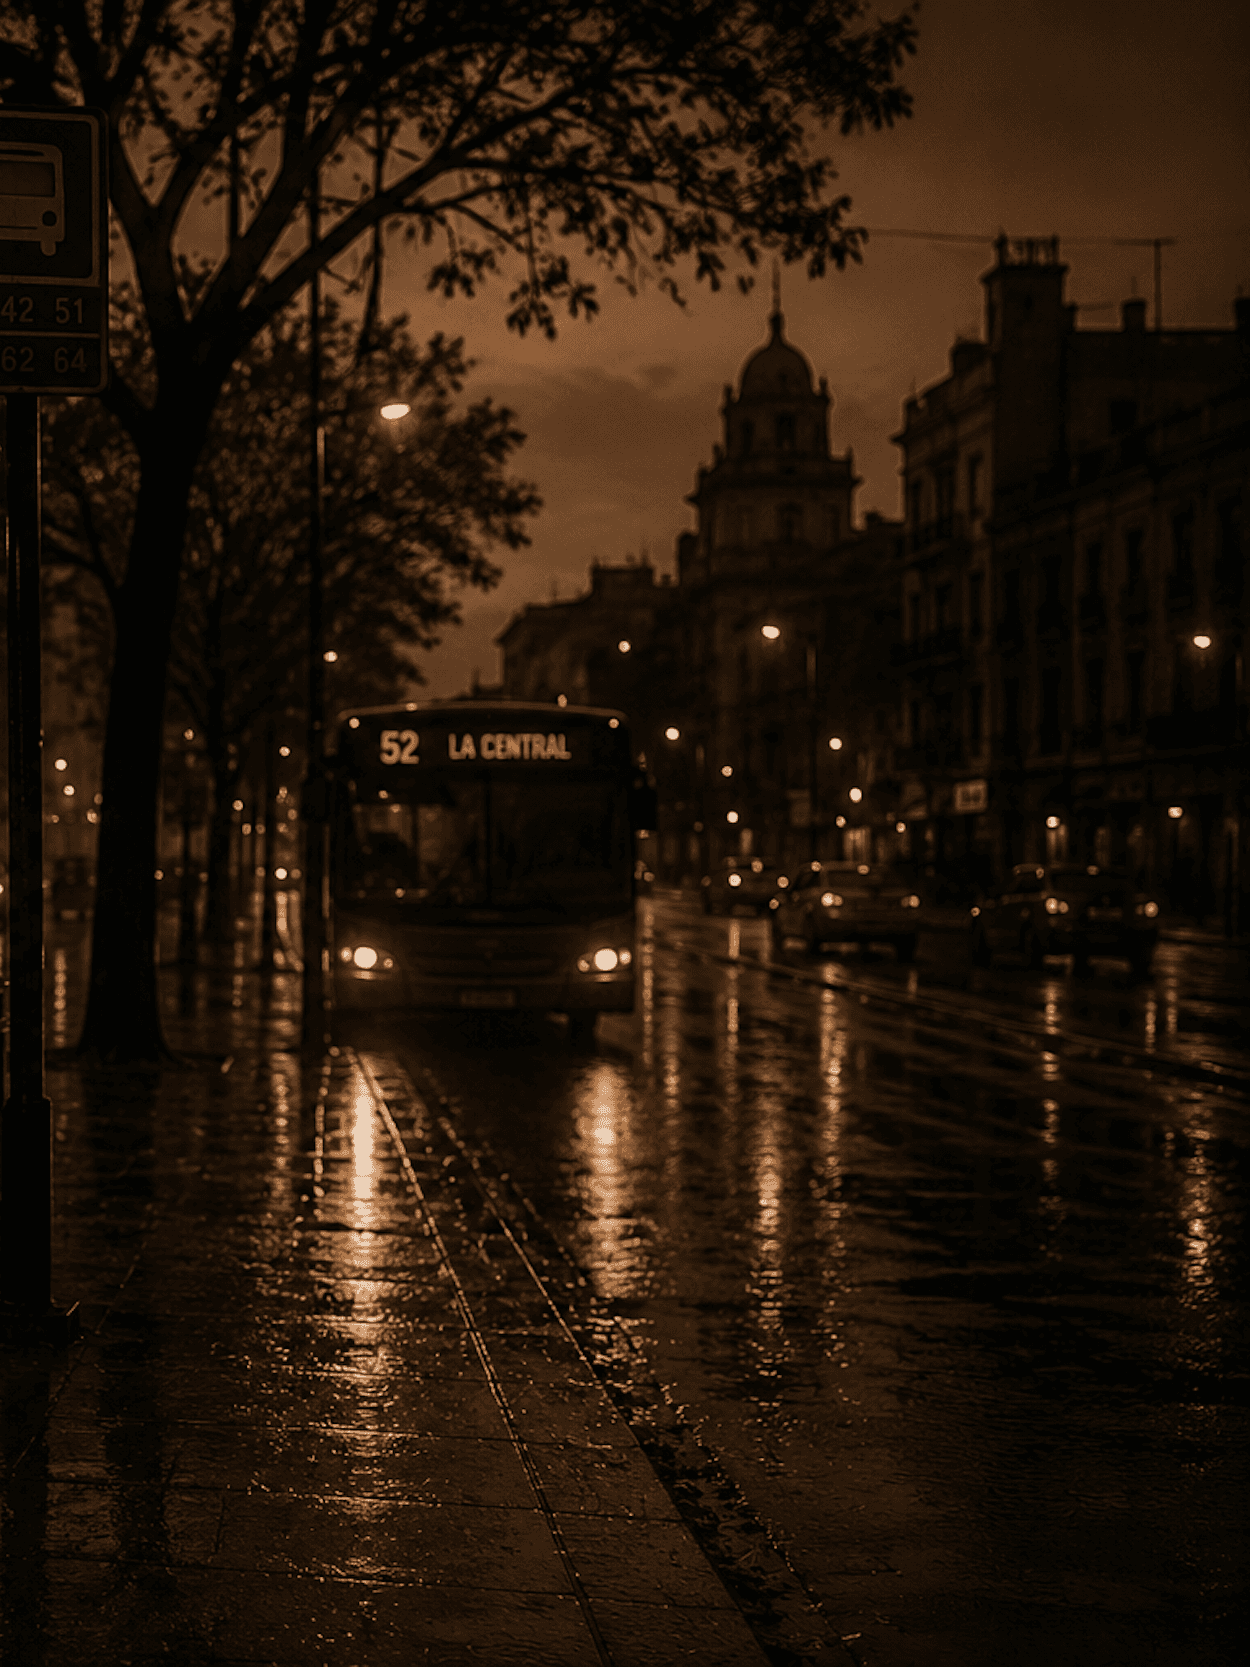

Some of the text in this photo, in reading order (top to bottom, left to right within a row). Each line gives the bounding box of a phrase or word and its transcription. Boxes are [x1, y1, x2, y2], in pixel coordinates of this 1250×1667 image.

[0, 296, 34, 323] 42
[54, 297, 84, 324] 51
[1, 346, 34, 372] 62
[54, 347, 87, 373] 64
[379, 729, 573, 765] 52 LA CENTRAL
